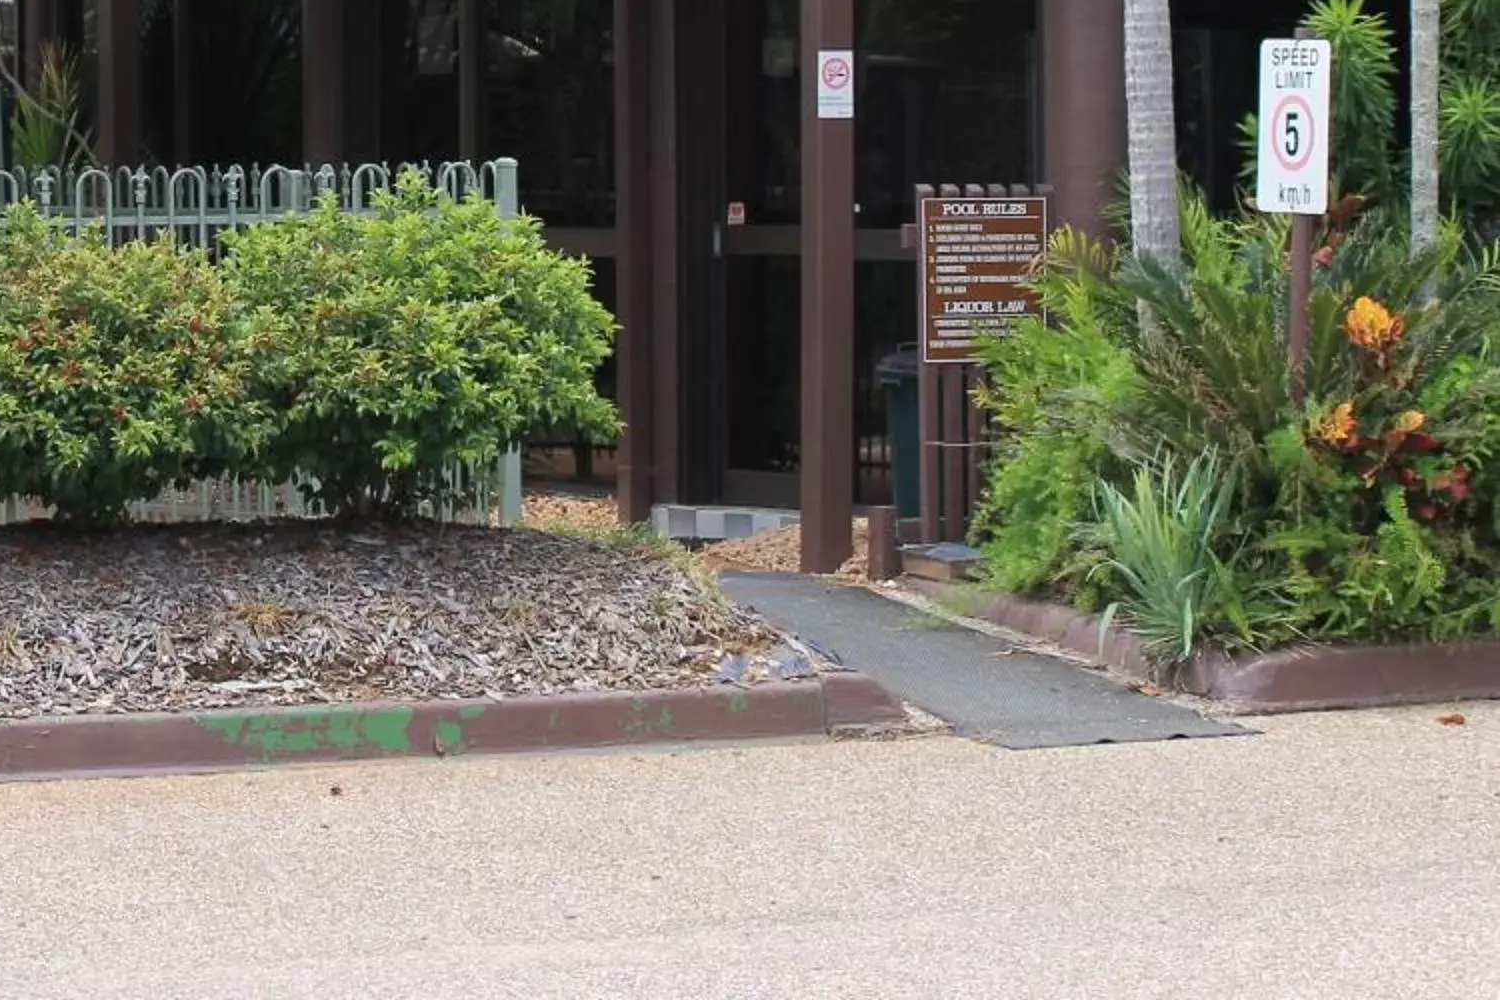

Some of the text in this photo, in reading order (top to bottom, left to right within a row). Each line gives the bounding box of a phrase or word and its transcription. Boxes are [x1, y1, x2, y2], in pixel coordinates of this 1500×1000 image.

[1271, 47, 1320, 67] SPEED
[1275, 71, 1314, 89] LIMIT
[1285, 112, 1300, 157] 5
[942, 203, 1027, 215] POOL RULES
[944, 301, 1026, 313] LIQUOR LAW
